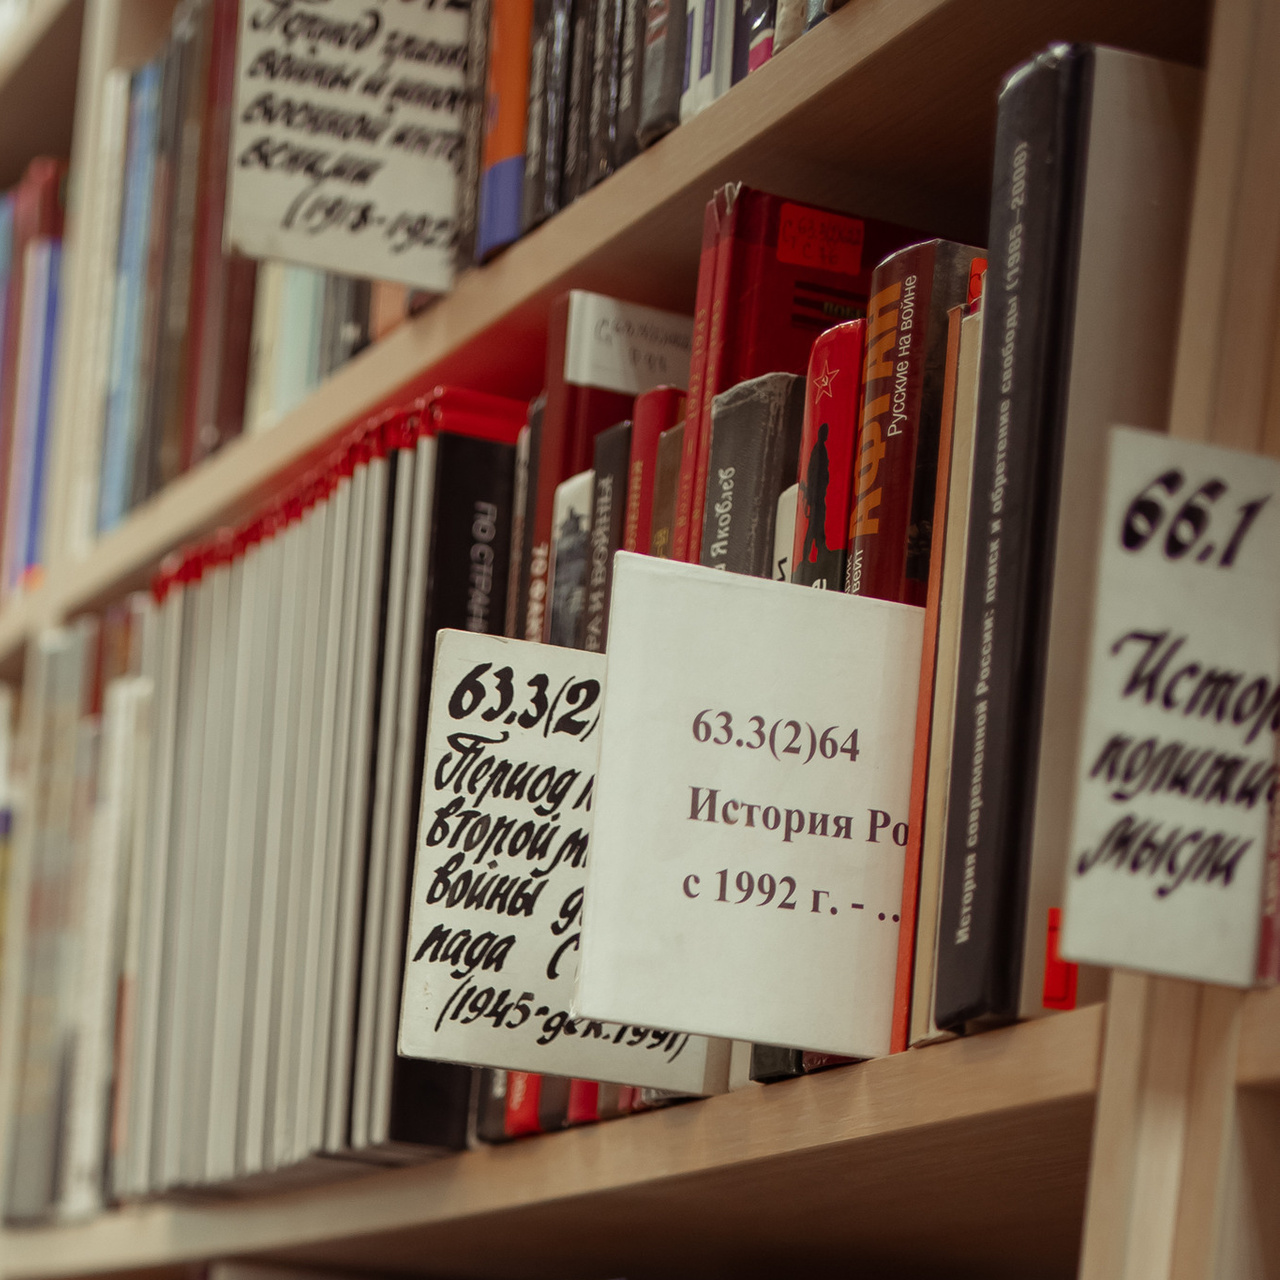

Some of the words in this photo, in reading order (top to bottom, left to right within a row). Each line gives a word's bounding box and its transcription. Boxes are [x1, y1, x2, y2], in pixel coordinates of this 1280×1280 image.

[901, 274, 918, 330] войне
[898, 331, 913, 357] на
[1001, 294, 1018, 395] свободы
[850, 281, 902, 540] АФГАН
[887, 359, 908, 437] Русские
[992, 397, 1011, 514] обретение
[990, 517, 1002, 539] и
[1118, 467, 1273, 570] 66.1
[985, 541, 1001, 604] поиск
[975, 608, 996, 697] России:
[692, 708, 860, 765] 63.3(2)64
[435, 731, 581, 817] Период
[967, 700, 988, 849] современной
[426, 795, 562, 867] второй
[687, 785, 854, 843] История
[865, 808, 909, 847] Ро
[426, 849, 549, 917] войны
[682, 873, 701, 899] с
[714, 868, 798, 910] 1992
[810, 889, 839, 915] г.
[954, 852, 977, 945] История
[413, 922, 517, 981] пада
